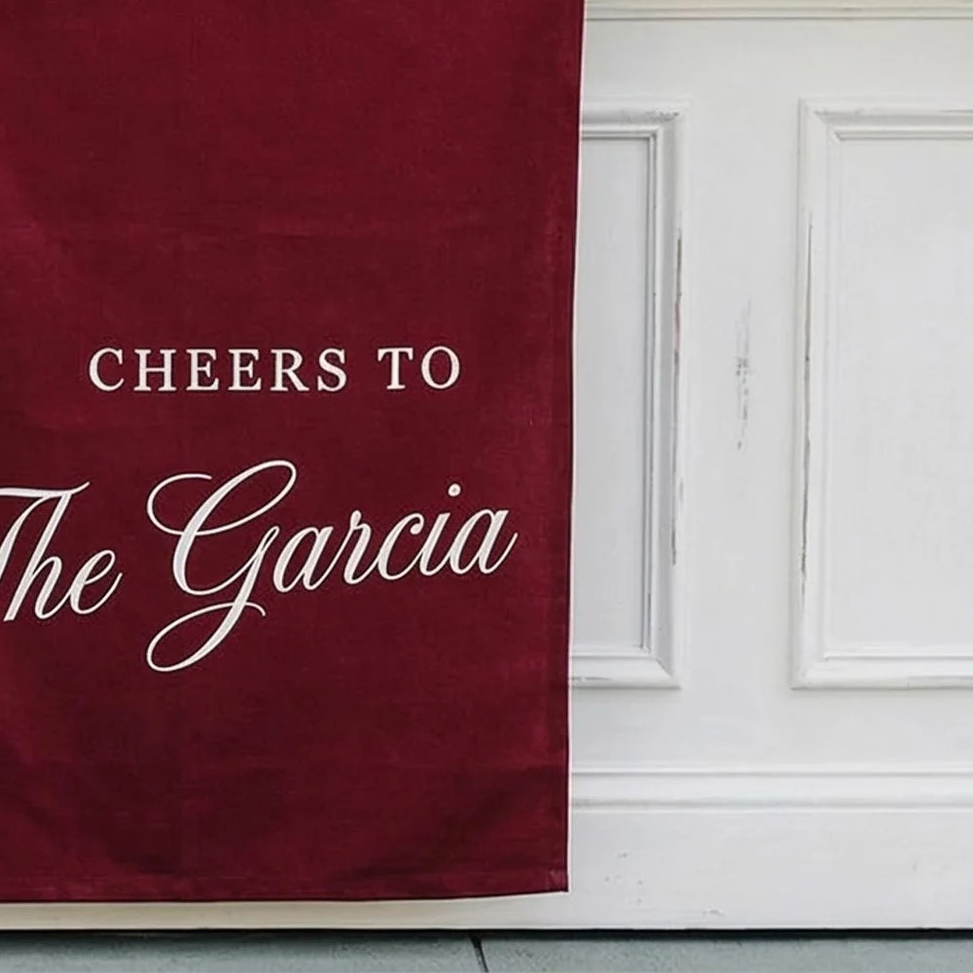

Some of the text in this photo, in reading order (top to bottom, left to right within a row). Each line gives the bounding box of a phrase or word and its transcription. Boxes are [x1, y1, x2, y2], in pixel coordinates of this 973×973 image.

[89, 345, 460, 392] CHEERS TO
[146, 460, 518, 672] Garcia
